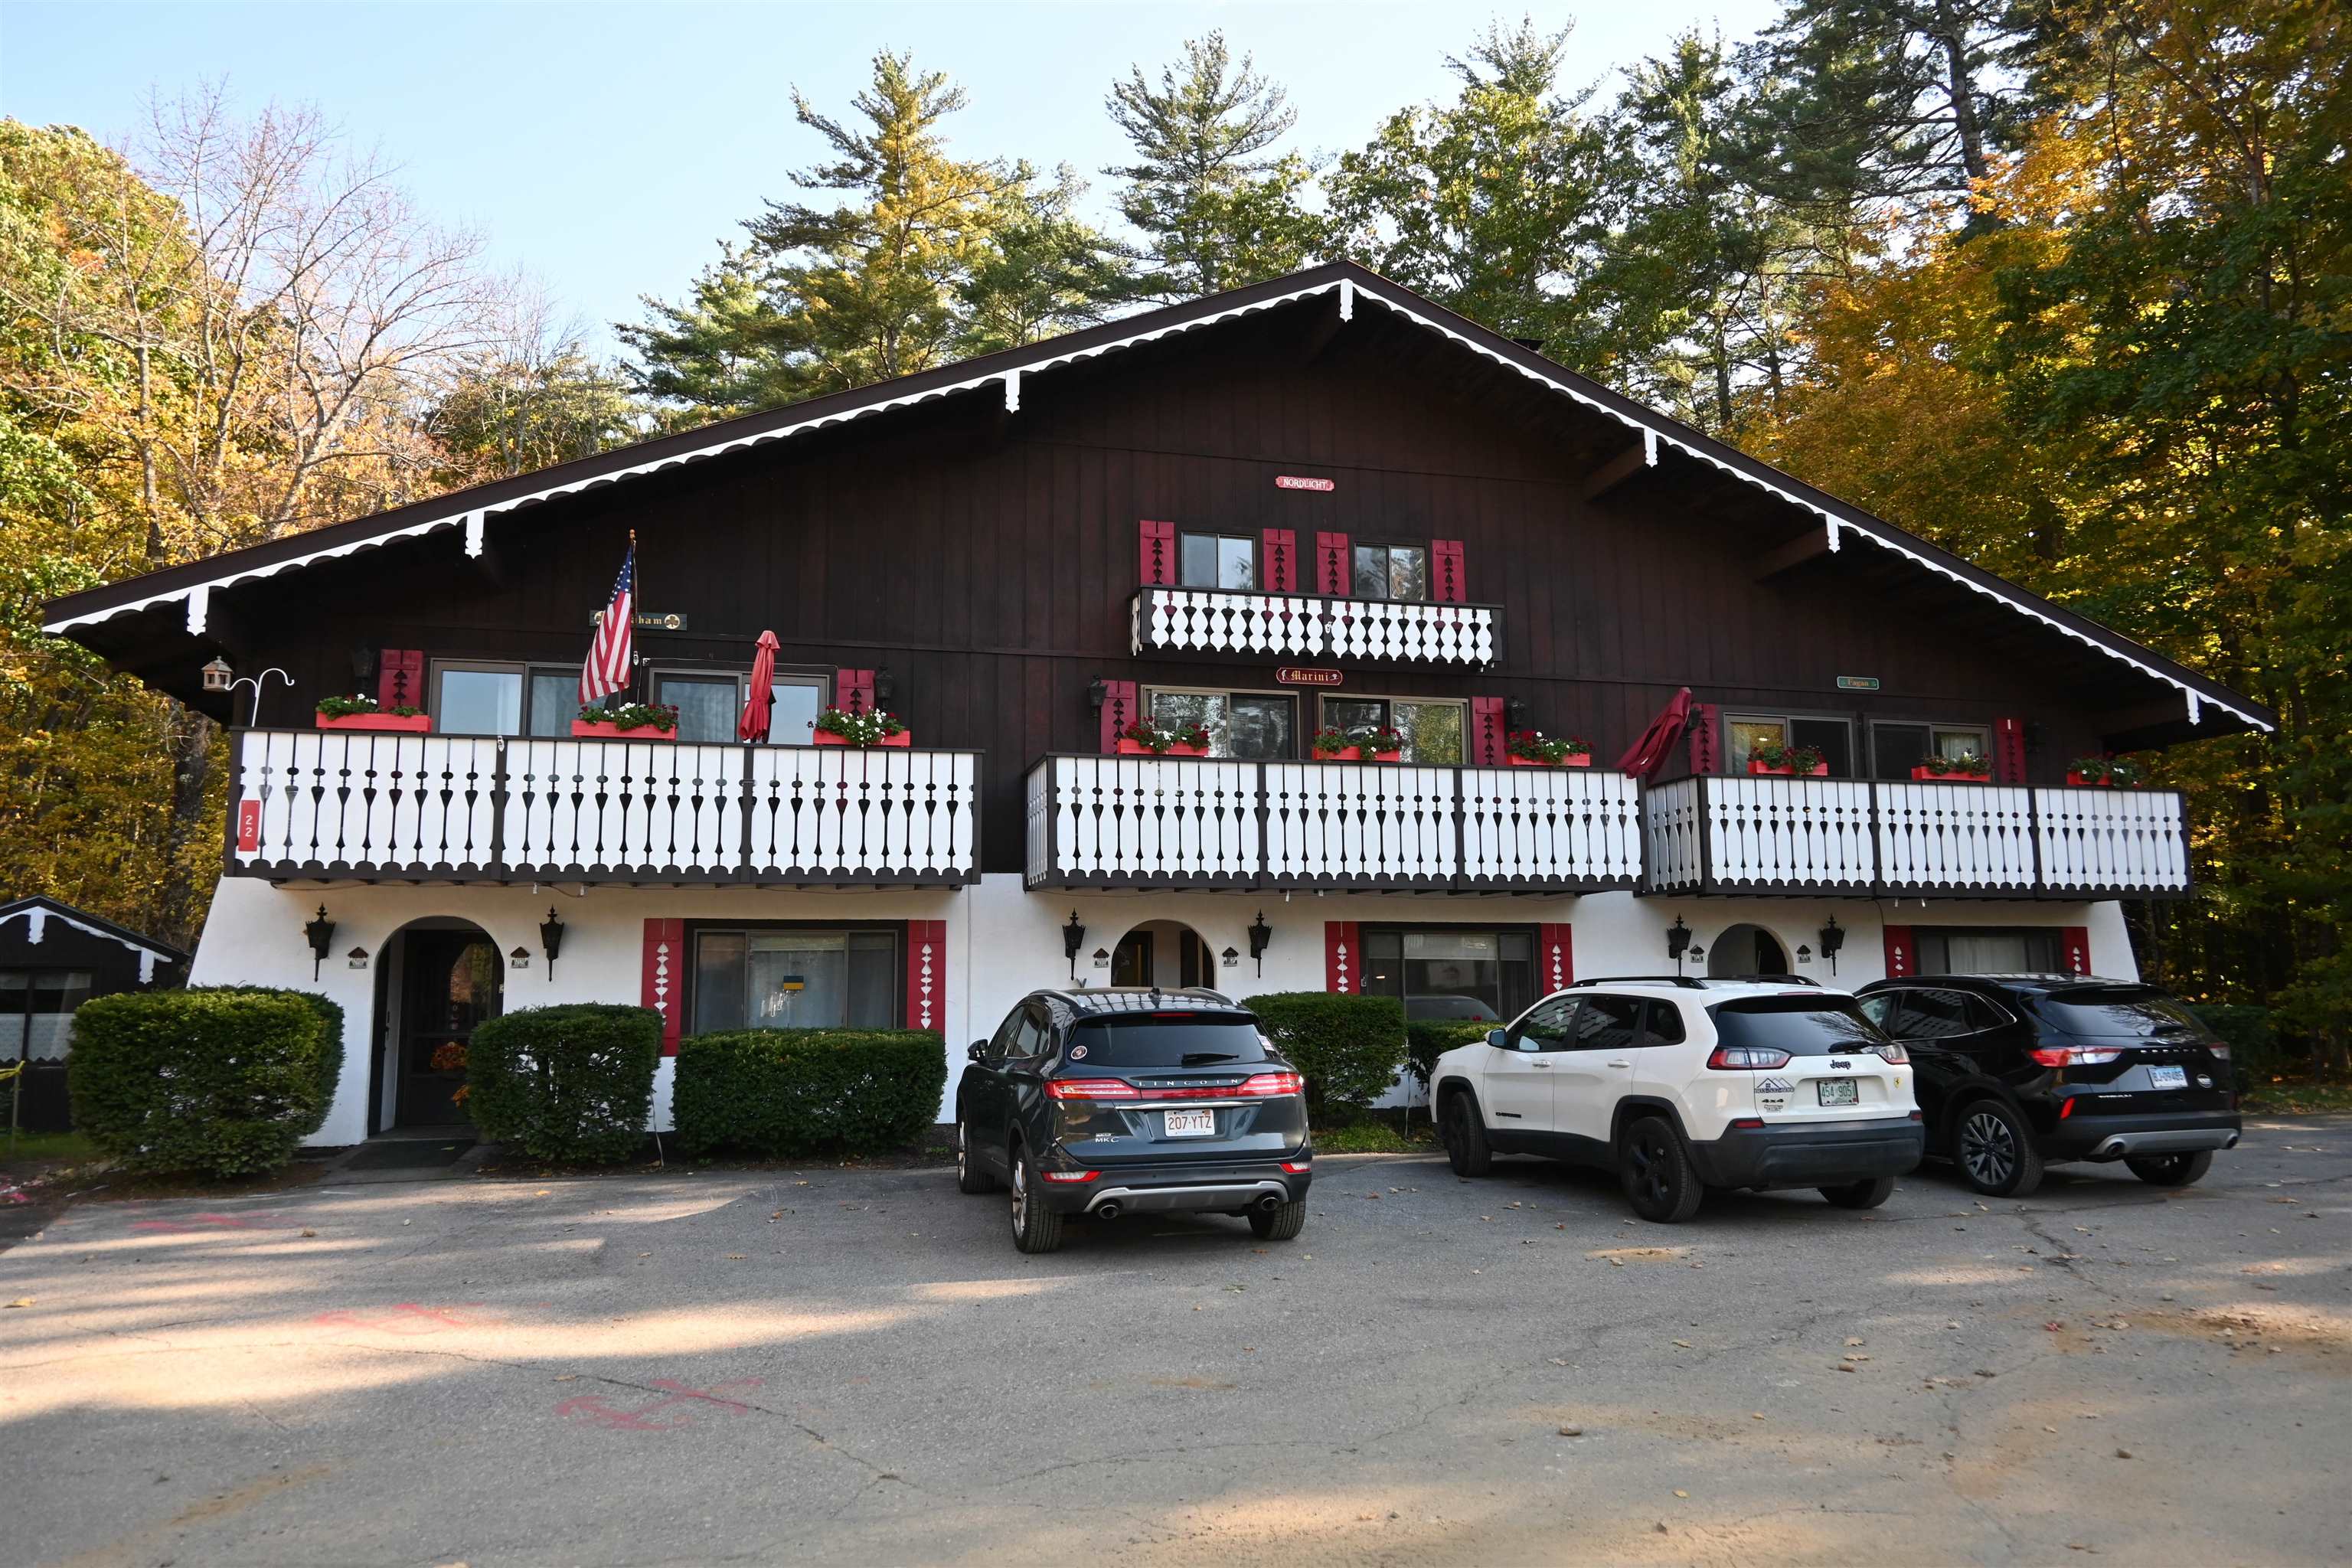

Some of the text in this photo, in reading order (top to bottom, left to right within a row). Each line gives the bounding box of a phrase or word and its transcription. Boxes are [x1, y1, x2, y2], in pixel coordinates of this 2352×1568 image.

[1283, 478, 1328, 488] NORDLICHT
[1291, 670, 1328, 681] Marini
[1830, 1059, 1851, 1070] Jeep
